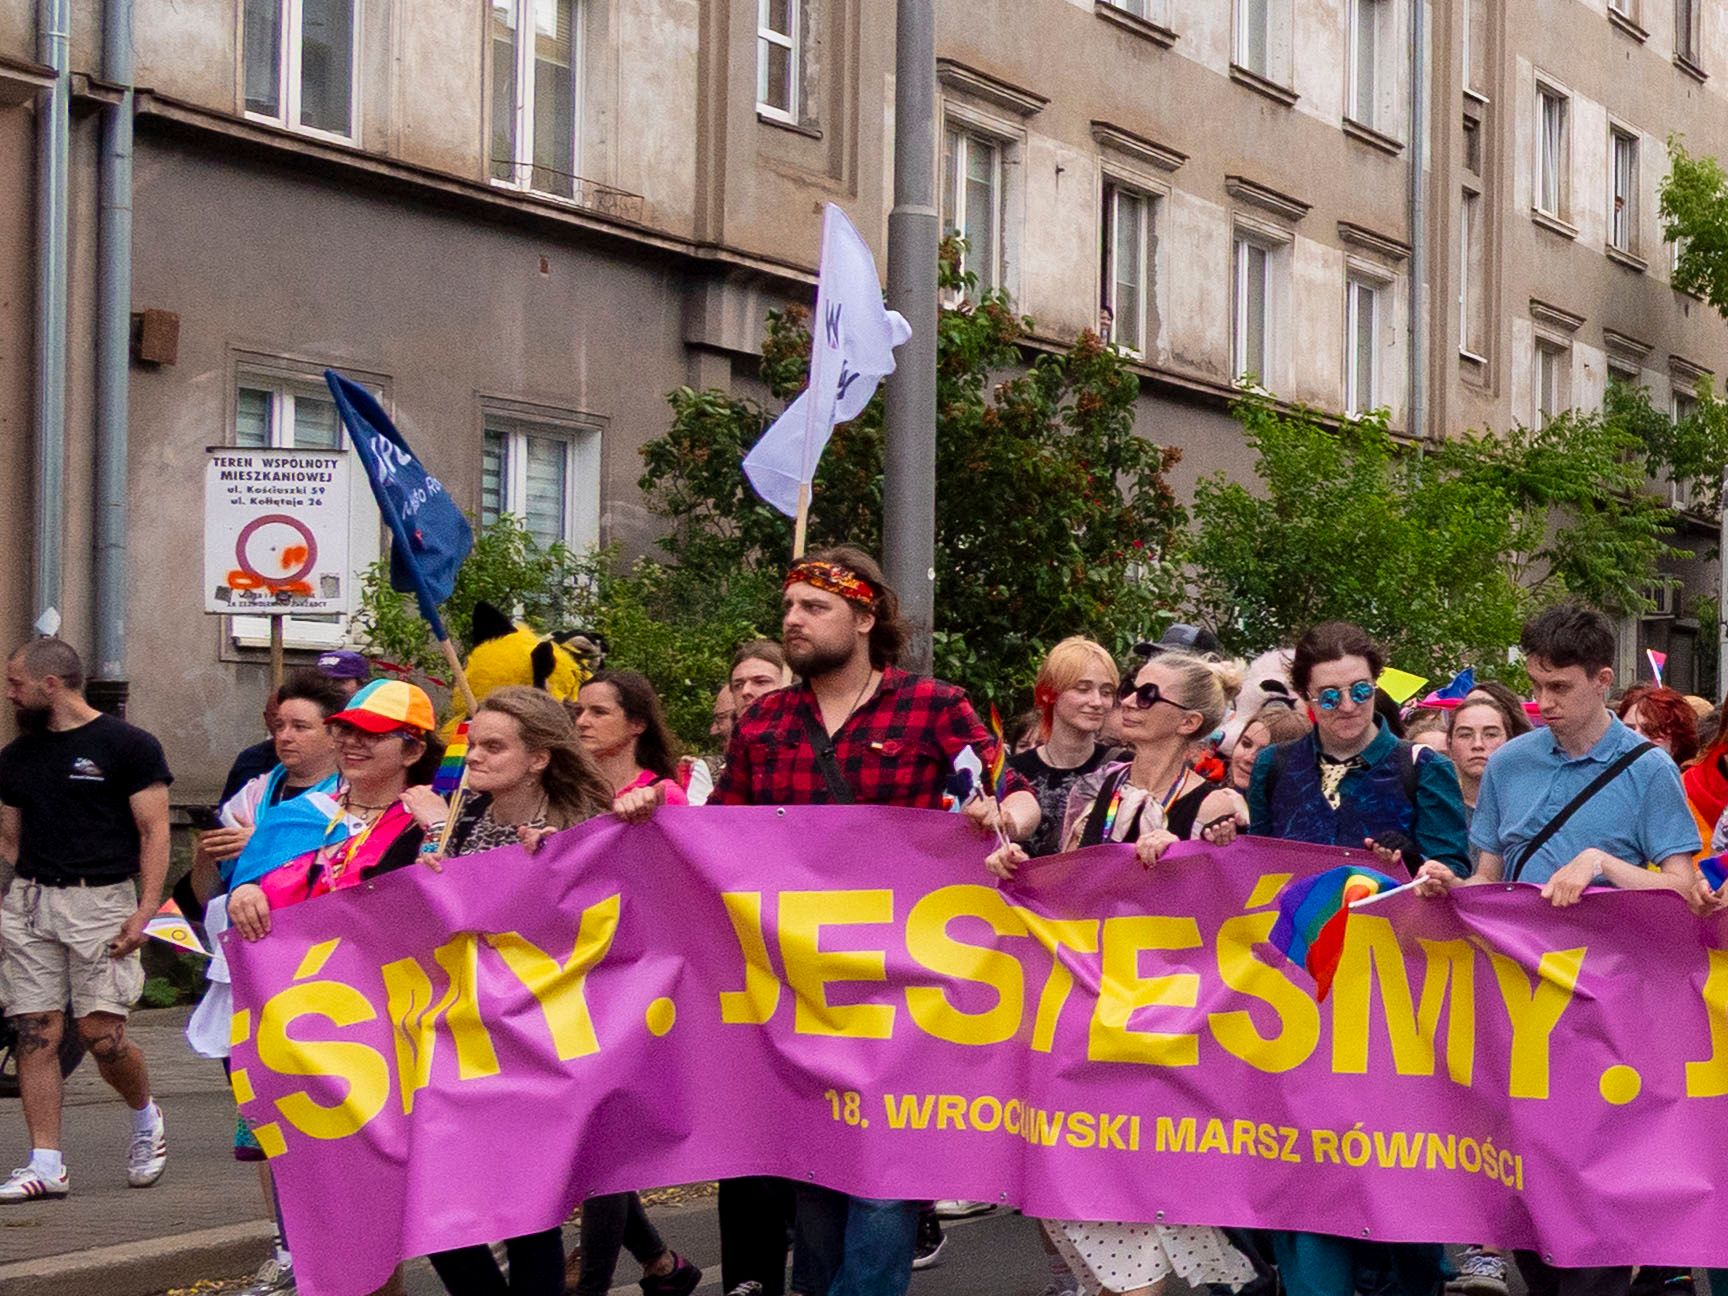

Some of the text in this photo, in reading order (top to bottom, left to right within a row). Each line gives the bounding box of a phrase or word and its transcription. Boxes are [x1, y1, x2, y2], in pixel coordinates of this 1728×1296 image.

[213, 455, 339, 469] TEREN WSPÓLNOTY
[220, 471, 333, 483] MIESZKANIOWEJ
[227, 486, 242, 494] ul.
[311, 486, 326, 495] 59
[230, 497, 246, 505] ul.
[308, 498, 323, 506] 26
[720, 873, 1642, 1105] JESTEŚMY.
[825, 1088, 1524, 1191] 18. WROCWSKI MARSZ RÓWNOŚCI
